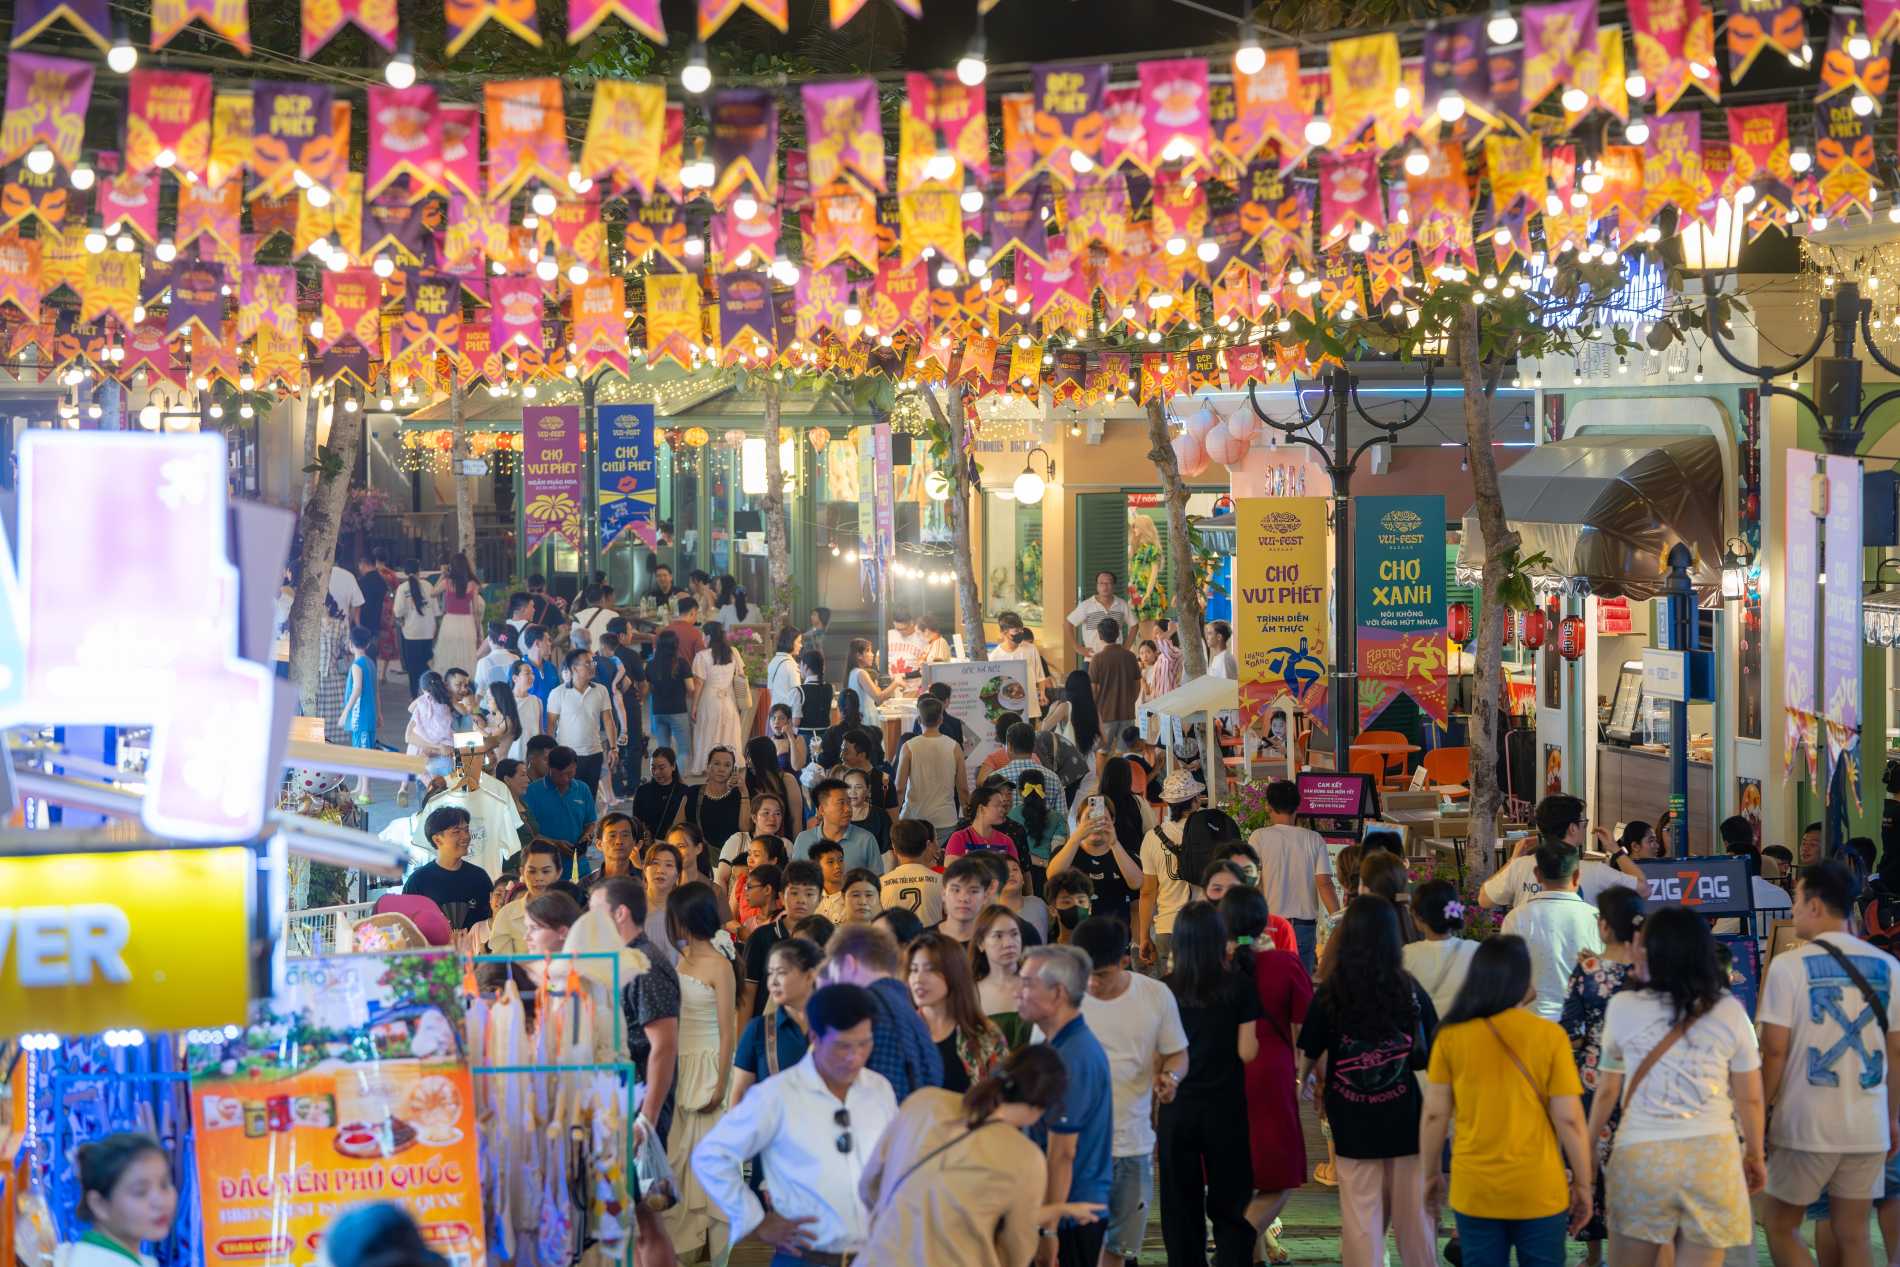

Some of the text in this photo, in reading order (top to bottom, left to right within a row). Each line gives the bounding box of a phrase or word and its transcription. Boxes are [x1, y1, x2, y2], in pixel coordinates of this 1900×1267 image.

[1265, 563, 1299, 586] CHỢ
[1379, 558, 1421, 585] CHỢ
[1242, 584, 1324, 604] VUI PHẾT
[1371, 585, 1433, 607] XANH
[1646, 871, 1731, 906] ZIGZAG
